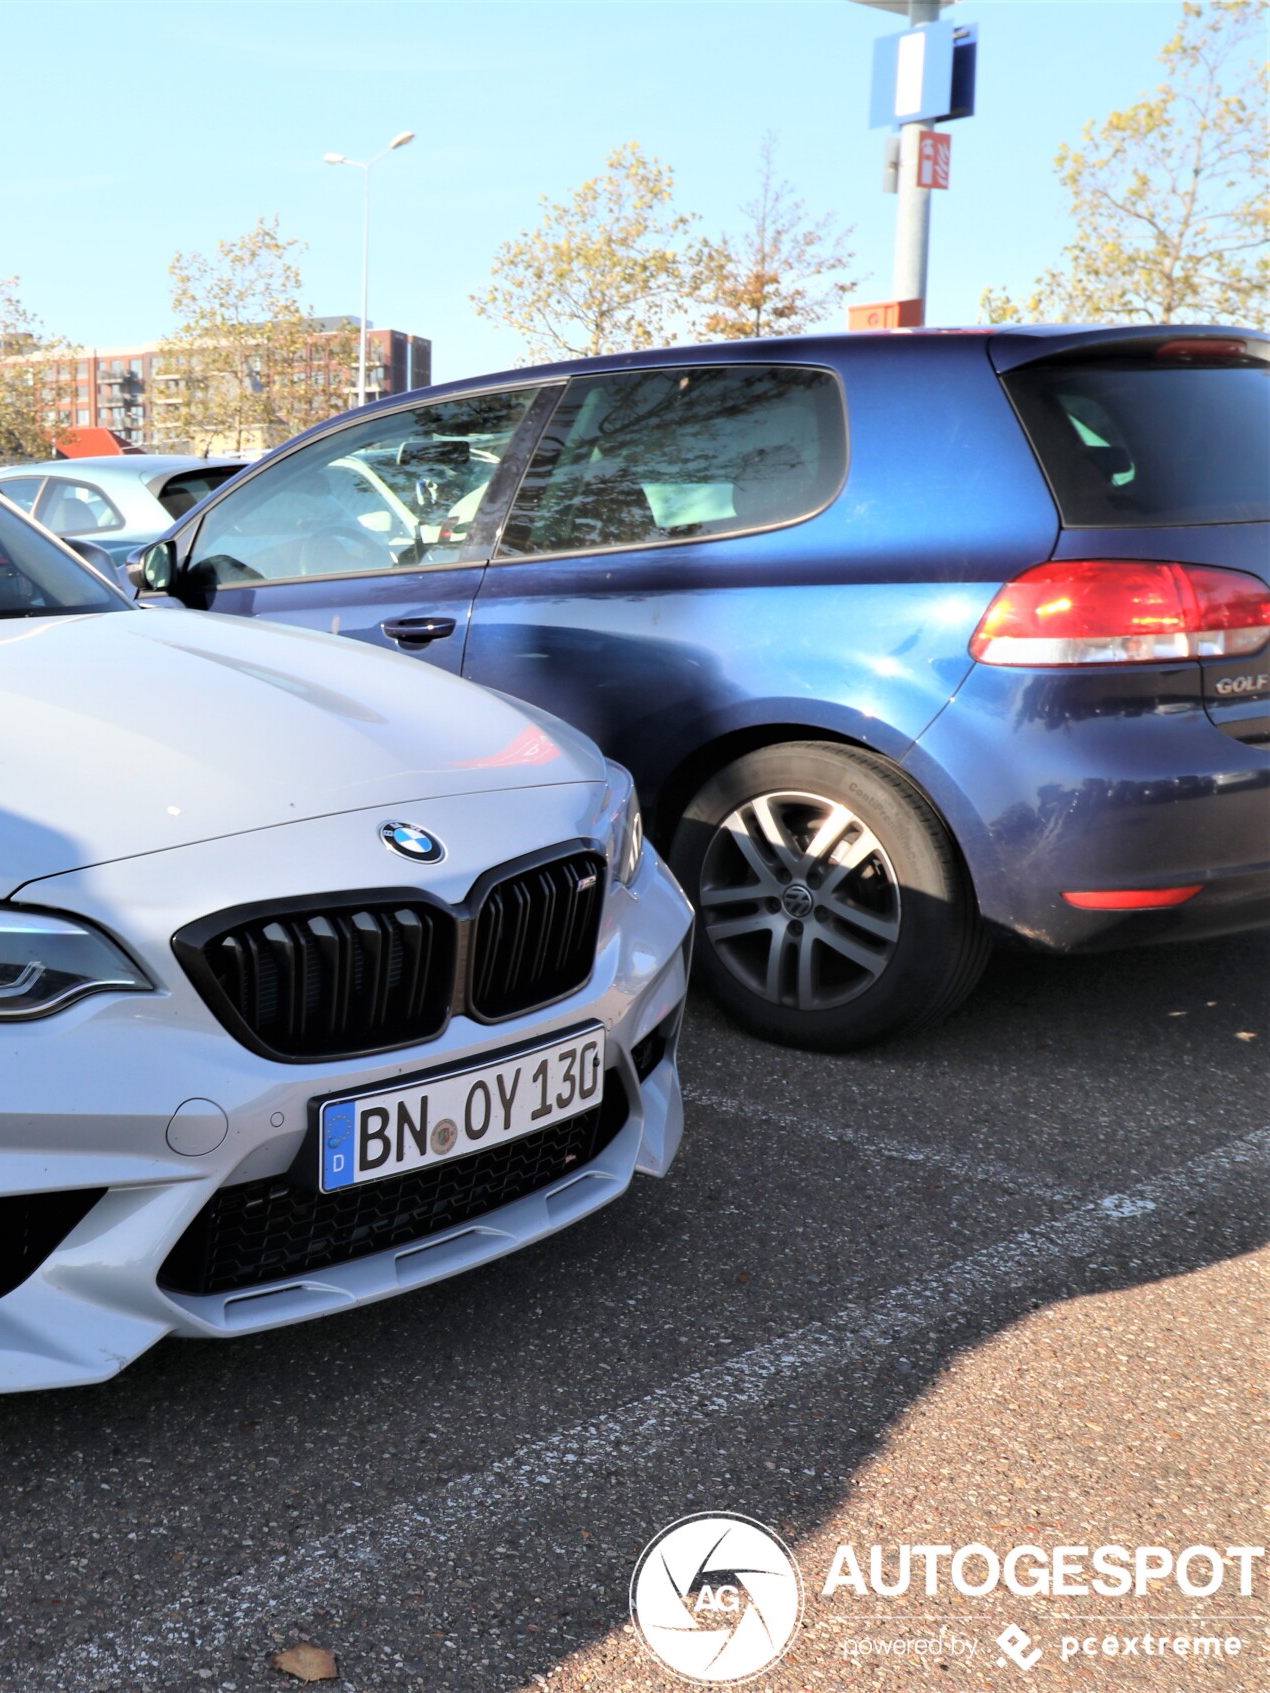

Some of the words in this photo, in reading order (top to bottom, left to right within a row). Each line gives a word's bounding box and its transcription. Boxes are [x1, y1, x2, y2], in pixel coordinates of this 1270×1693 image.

[1215, 674, 1269, 695] GOLF
[332, 1154, 344, 1174] D
[358, 1095, 429, 1172] BN
[464, 1067, 522, 1141] OY
[531, 1040, 599, 1121] 130
